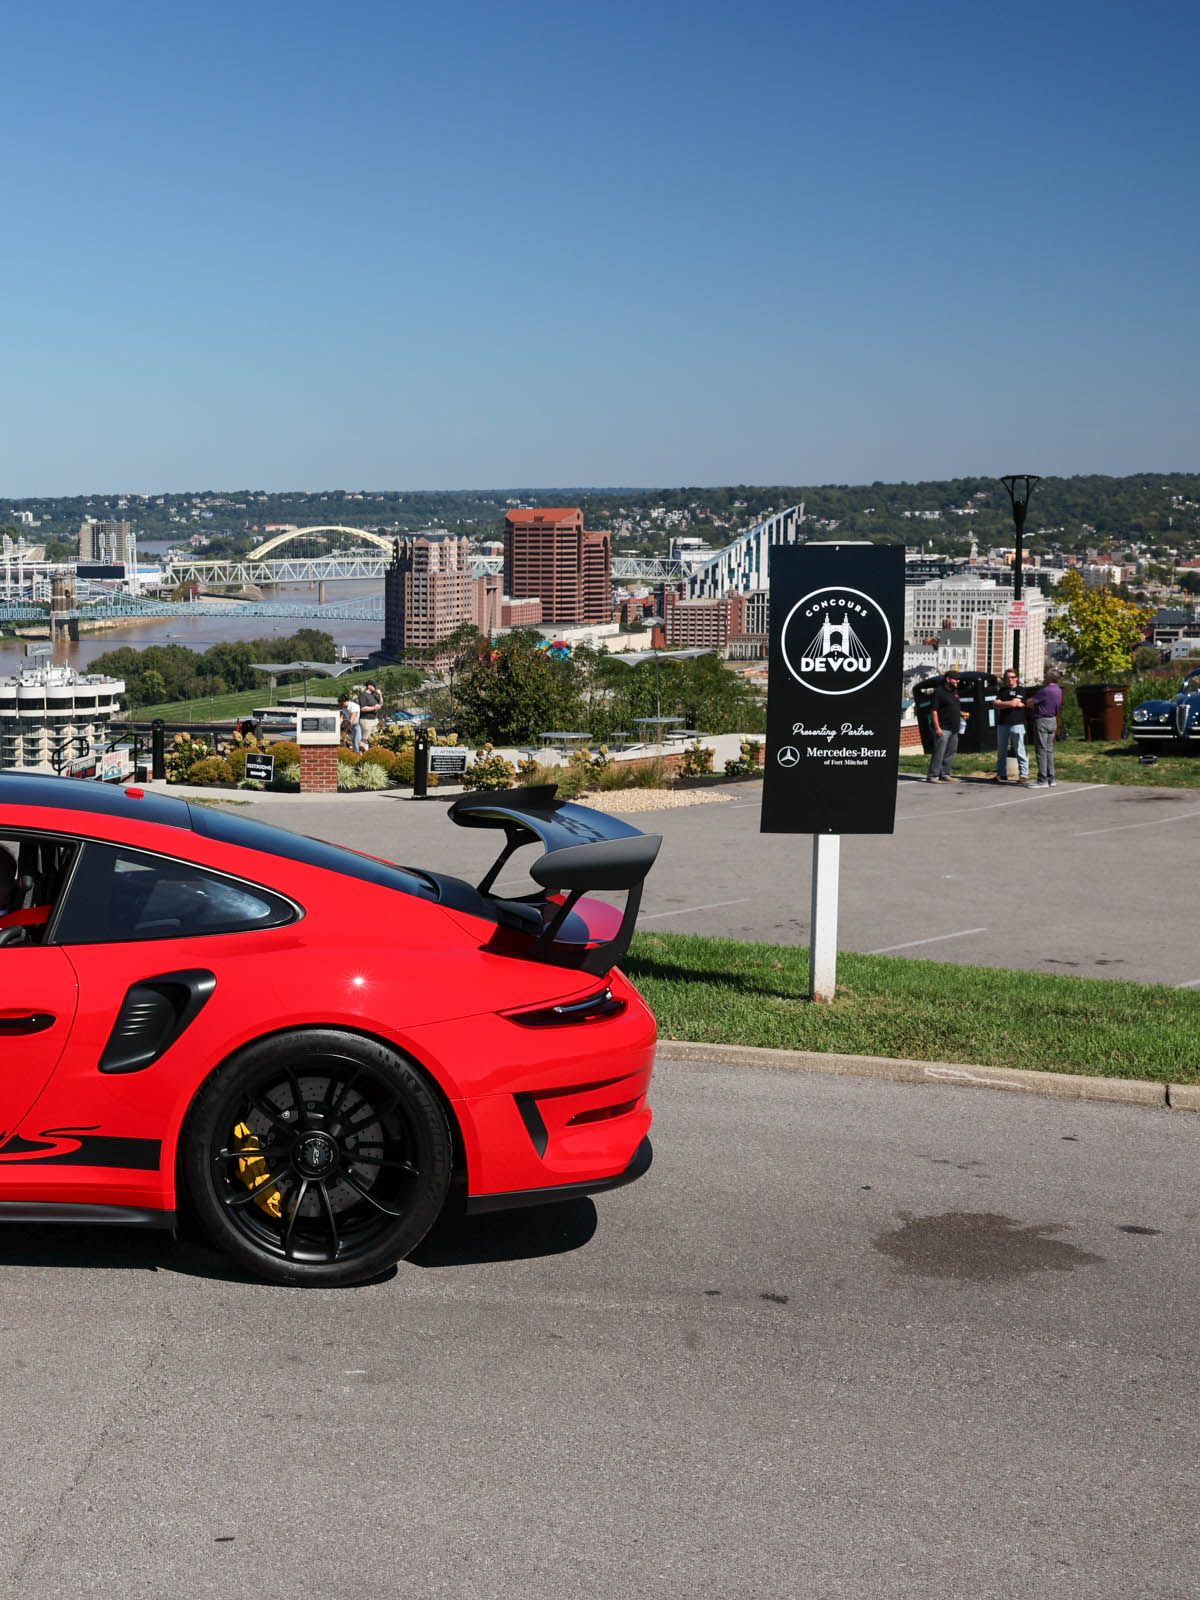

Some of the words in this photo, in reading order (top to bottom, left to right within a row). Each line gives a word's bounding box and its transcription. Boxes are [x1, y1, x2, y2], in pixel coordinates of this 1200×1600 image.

[805, 599, 868, 617] CONCOURS
[800, 657, 872, 672] DEVOU
[792, 722, 838, 743] Presenting
[840, 722, 875, 736] Partner
[806, 747, 887, 757] Mercedes-Benz
